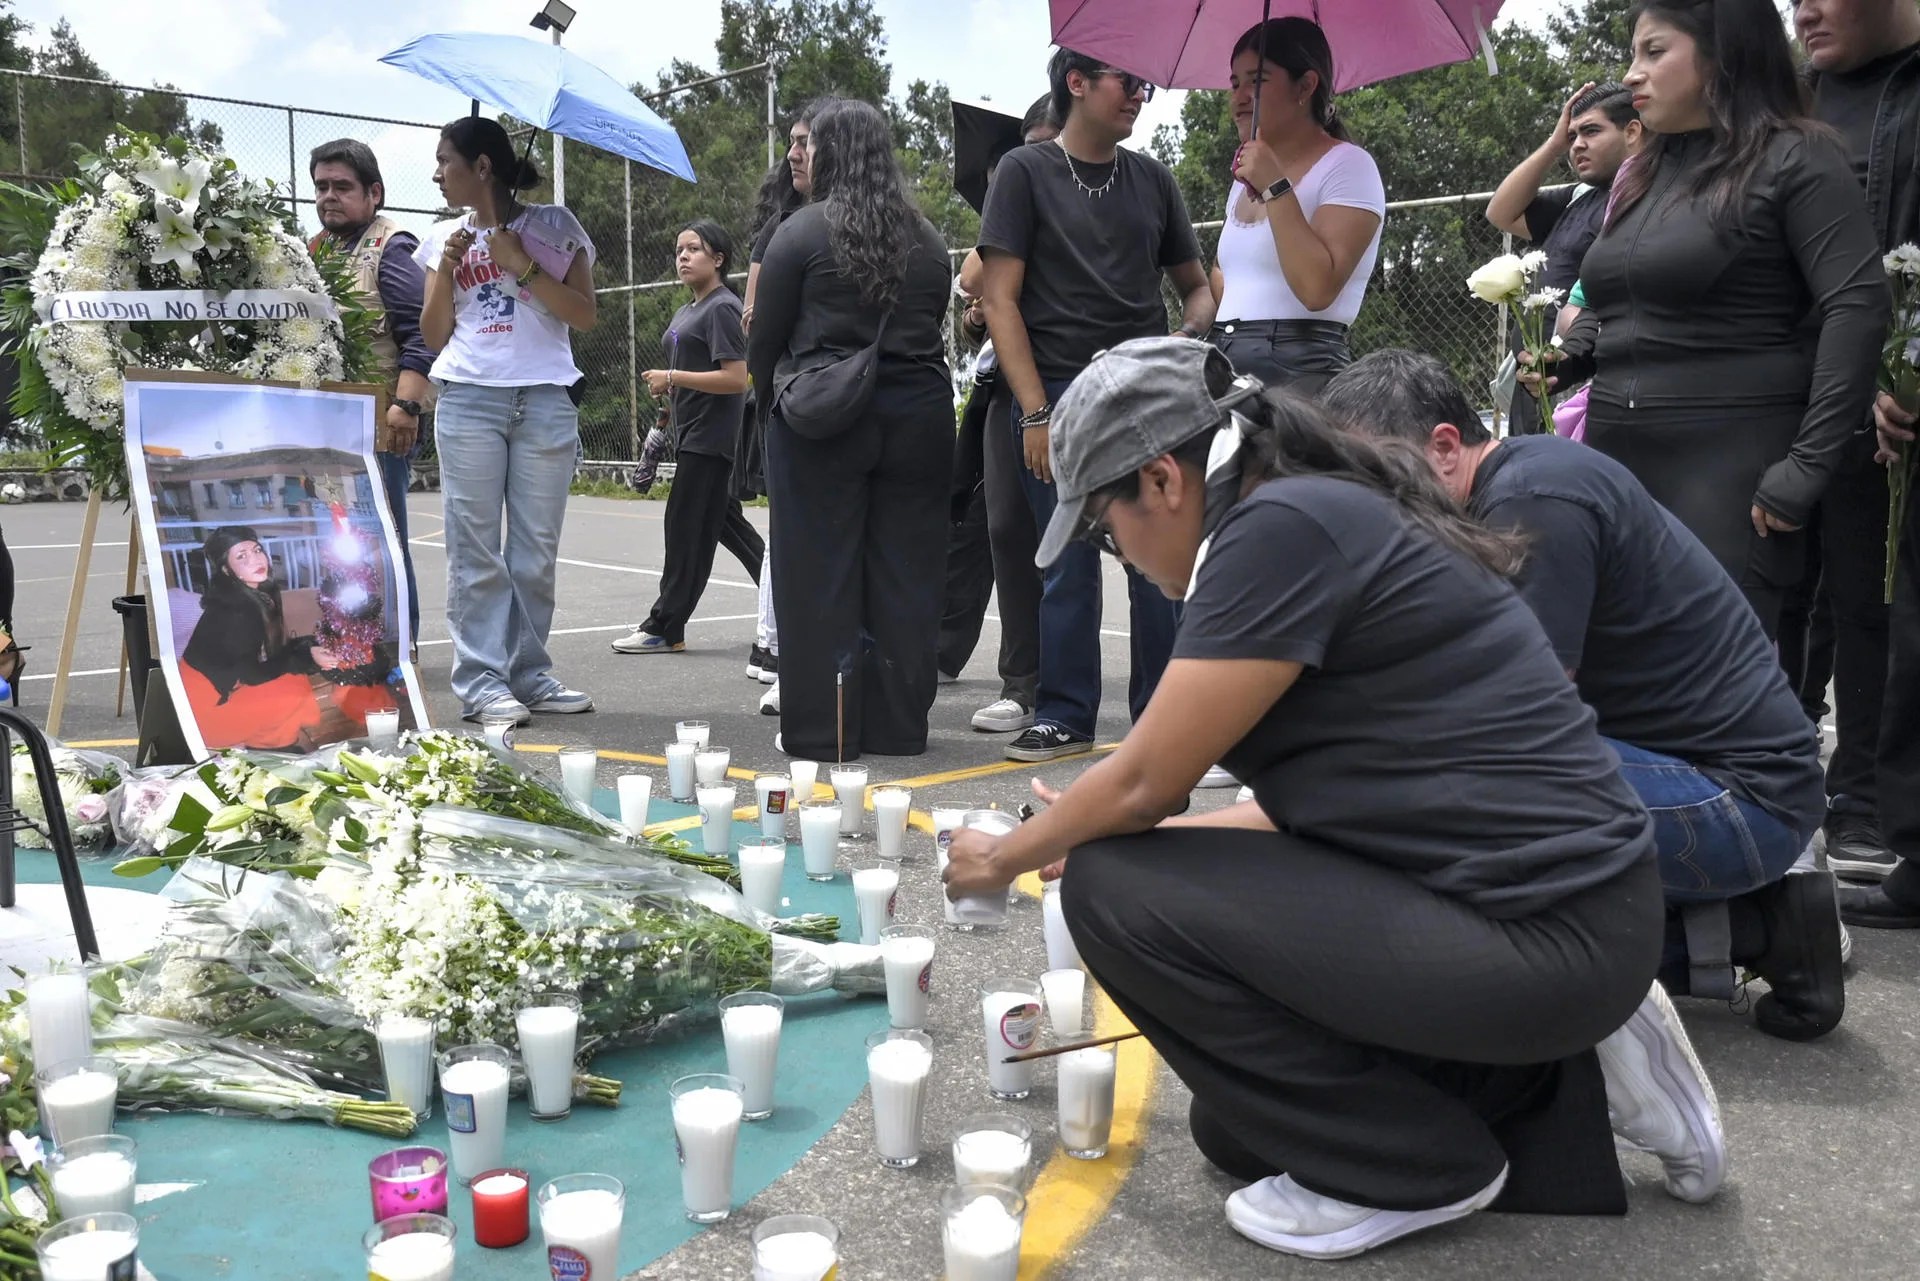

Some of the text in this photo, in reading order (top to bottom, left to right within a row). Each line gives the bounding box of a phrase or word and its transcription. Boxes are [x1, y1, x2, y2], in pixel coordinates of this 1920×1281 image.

[50, 299, 310, 321] CLAUDIA NO SE OLVIDA
